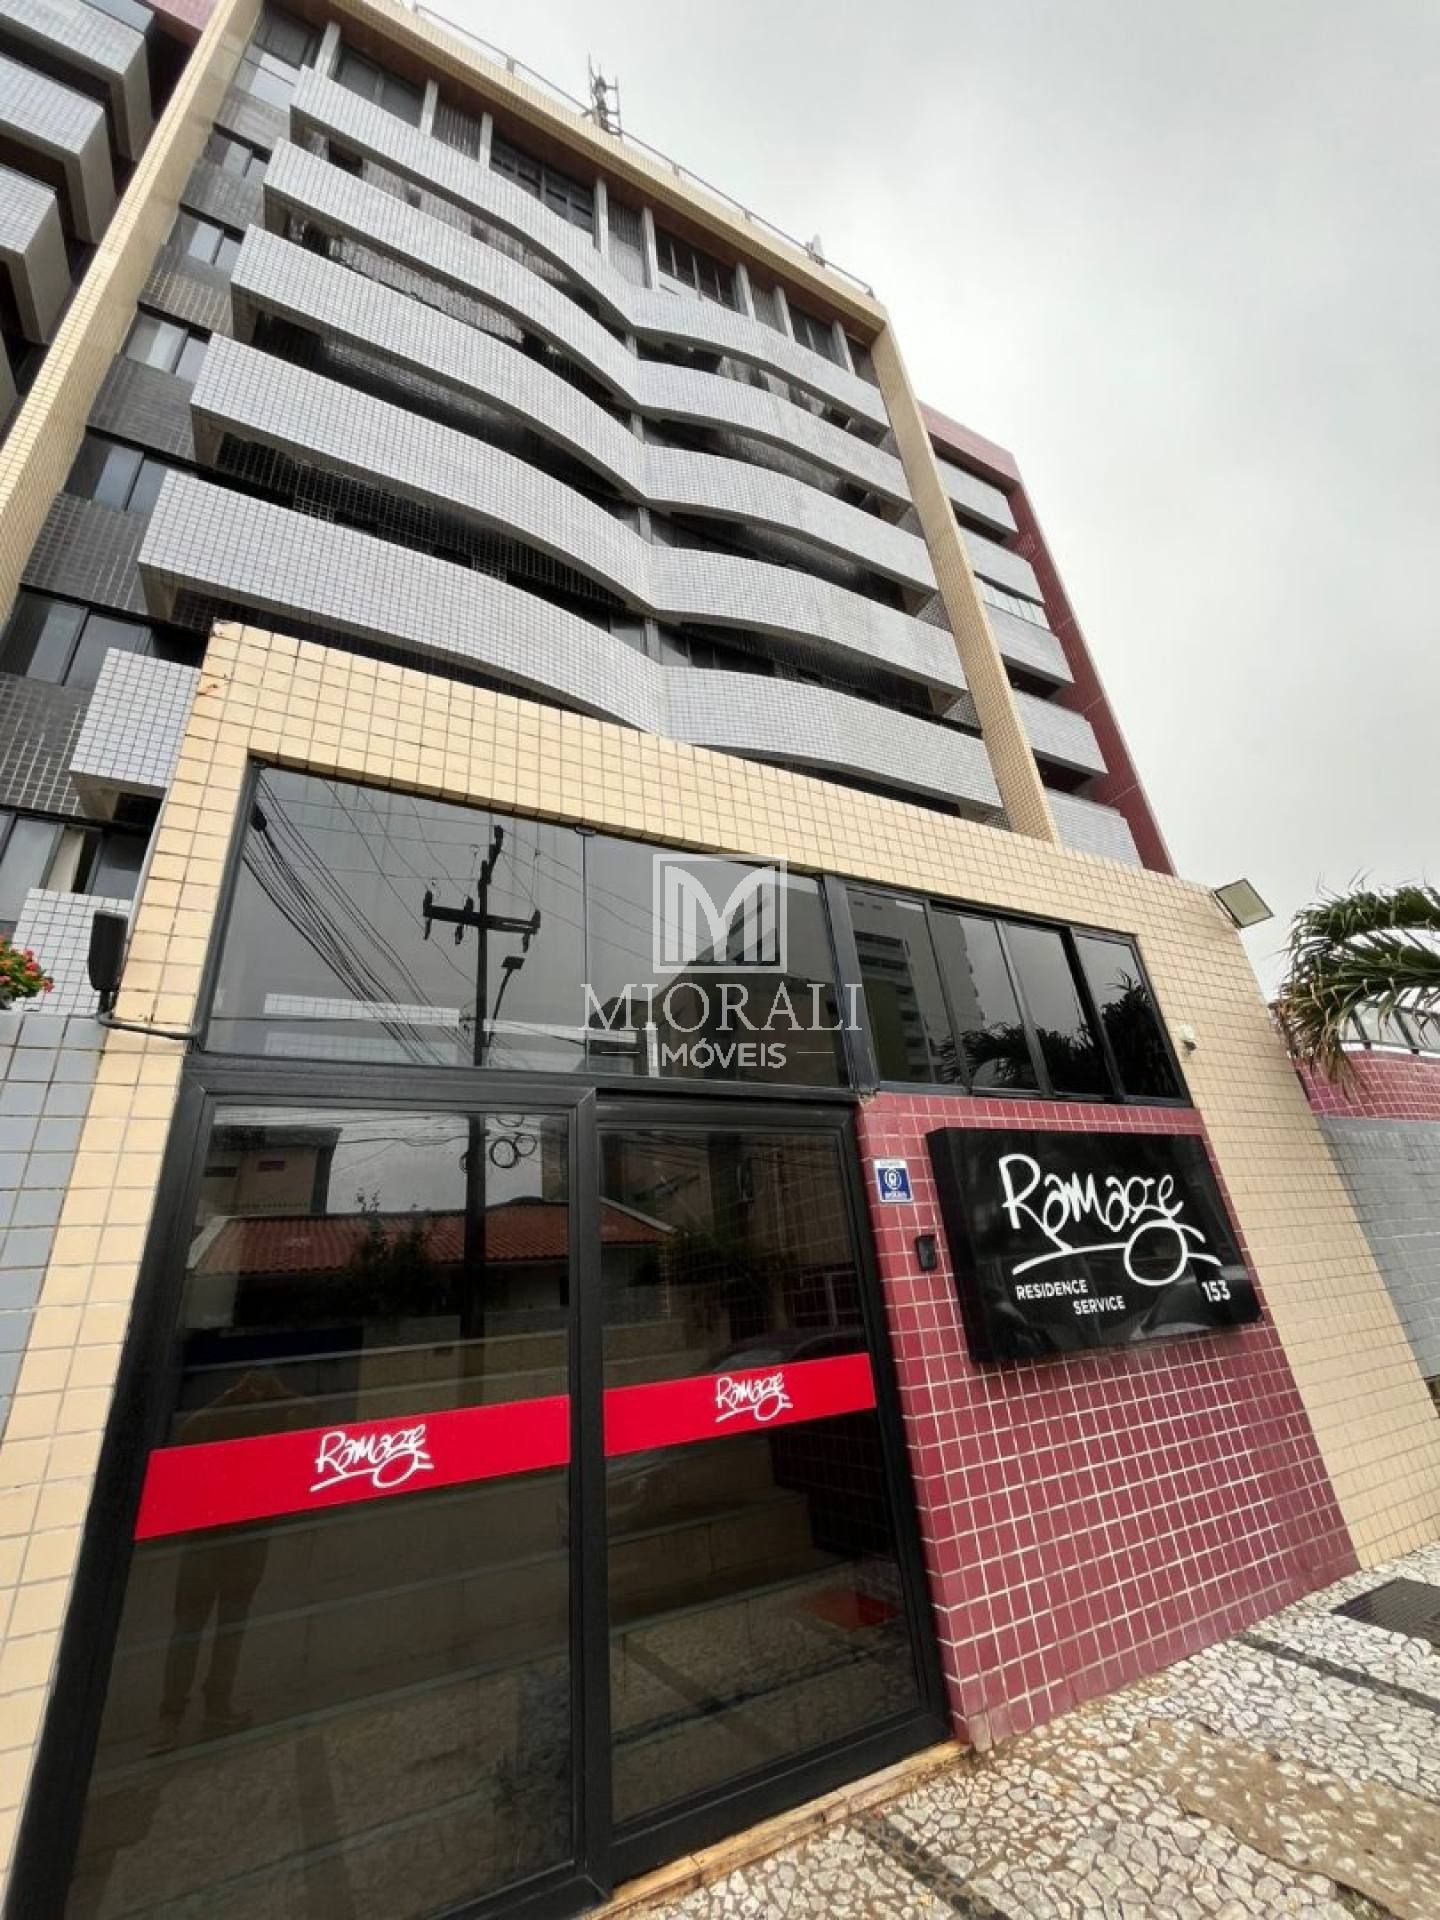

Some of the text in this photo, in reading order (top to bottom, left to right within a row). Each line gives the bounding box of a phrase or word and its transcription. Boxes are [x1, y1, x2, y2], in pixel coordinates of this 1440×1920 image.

[1015, 1279, 1089, 1300] RESIDENCE
[1202, 1280, 1231, 1301] 153
[1073, 1295, 1126, 1315] SERVICE
